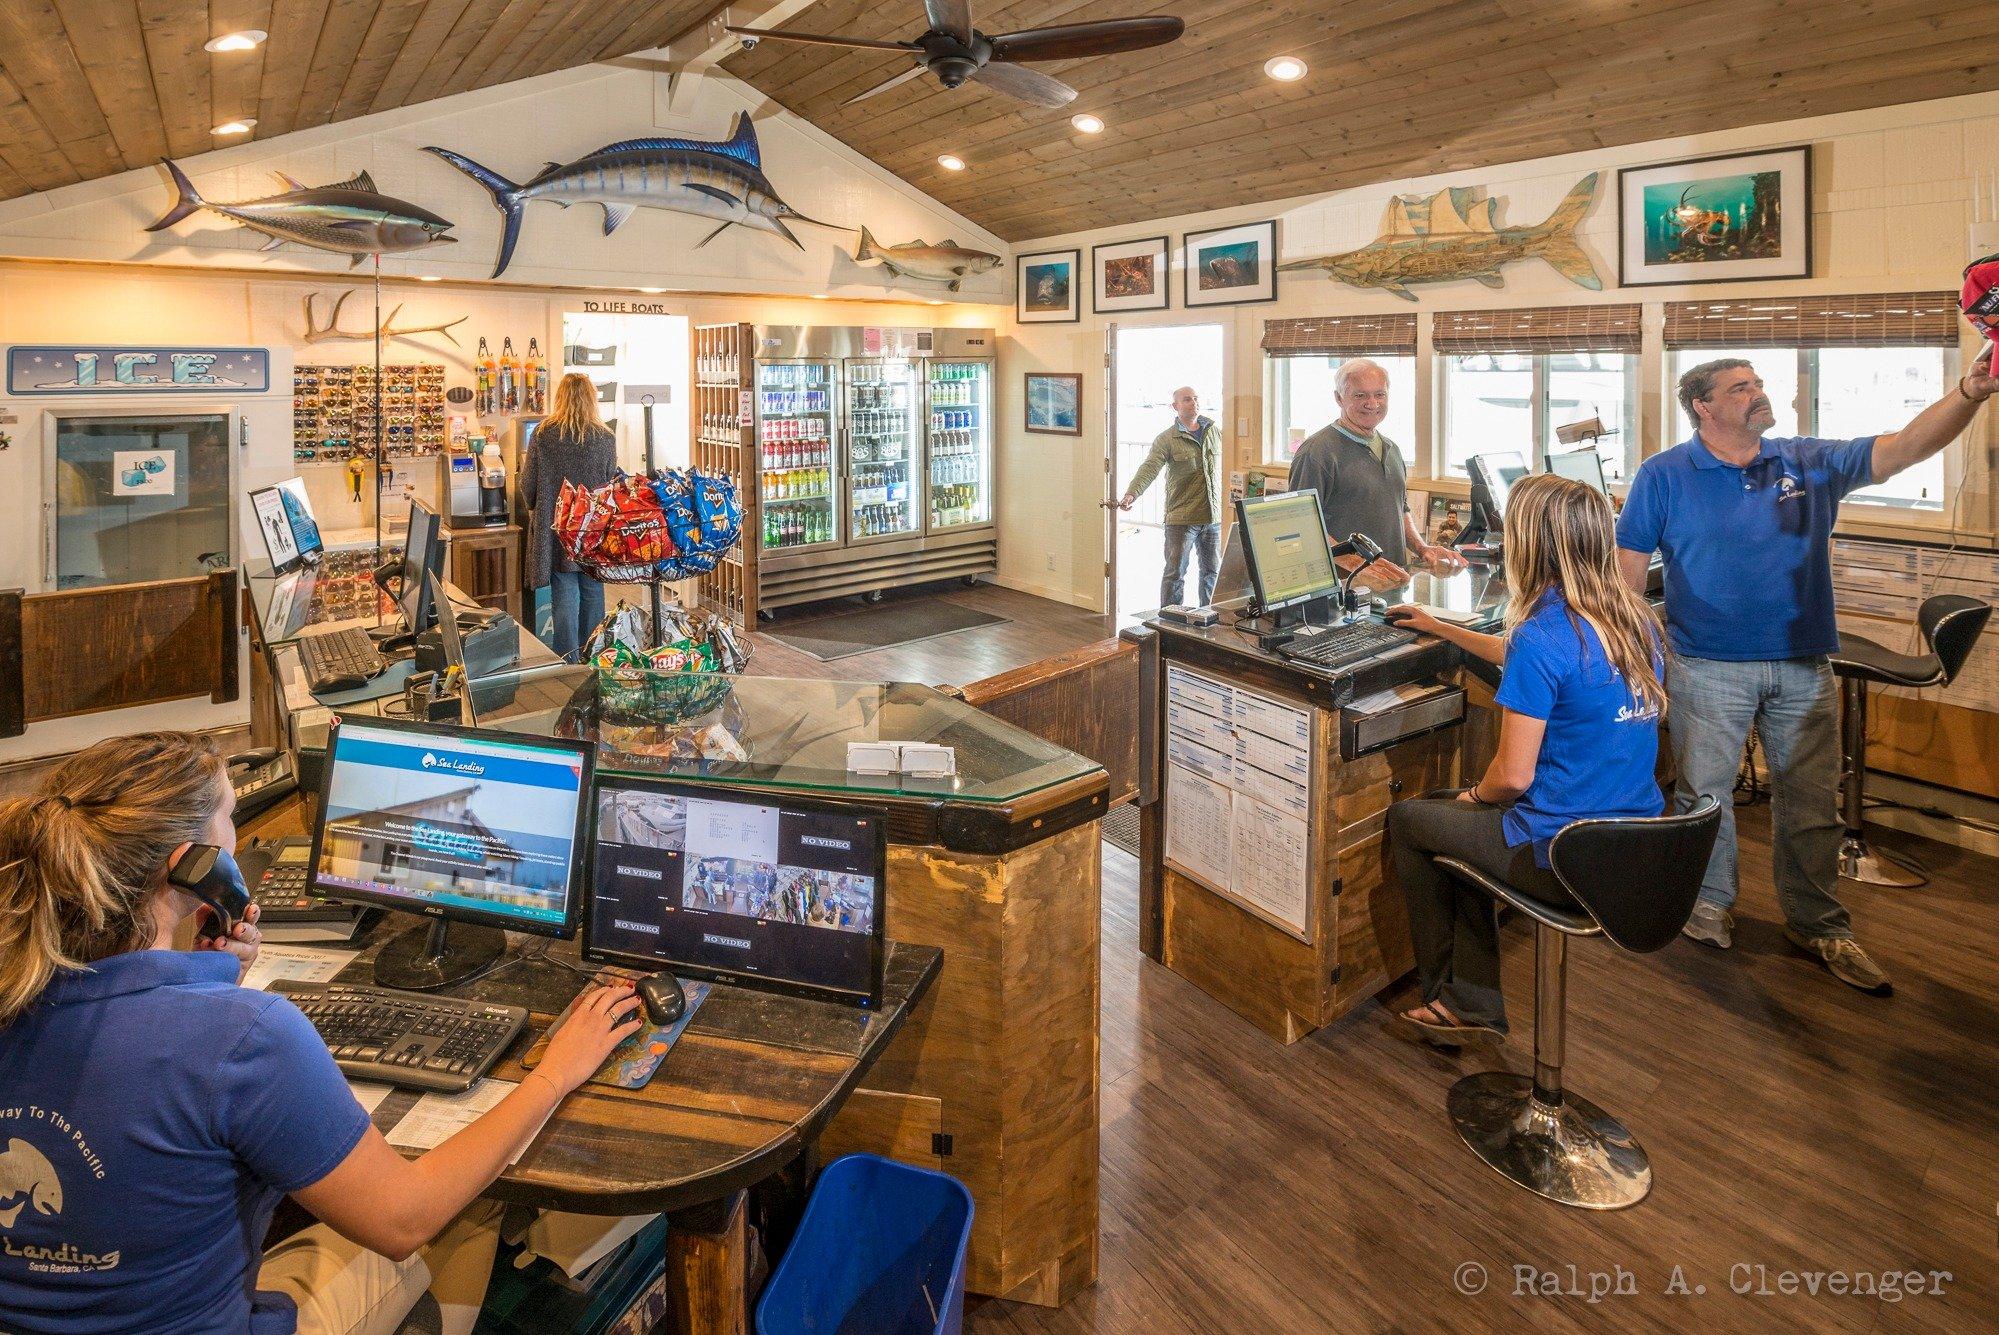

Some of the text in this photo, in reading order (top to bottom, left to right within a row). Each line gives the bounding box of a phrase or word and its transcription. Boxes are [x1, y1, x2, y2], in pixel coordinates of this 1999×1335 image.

[583, 301, 665, 315] TO LIFE BOATS
[73, 352, 219, 386] ICE
[133, 460, 156, 471] ICE
[619, 518, 660, 537] Doritos
[436, 757, 452, 768] Sea
[453, 758, 485, 775] Landing
[384, 821, 406, 831] Welcome
[819, 839, 849, 849] VIDEO
[617, 866, 661, 879] NO VIDEO
[615, 919, 660, 934] NO VIDEO
[704, 935, 750, 948] NO VIDEO
[30, 1105, 44, 1119] To
[50, 1110, 71, 1133] The
[72, 1130, 105, 1179] Pacific
[3, 1236, 120, 1271] Landing
[28, 1261, 49, 1273] Santa
[49, 1262, 81, 1274] Barbara,
